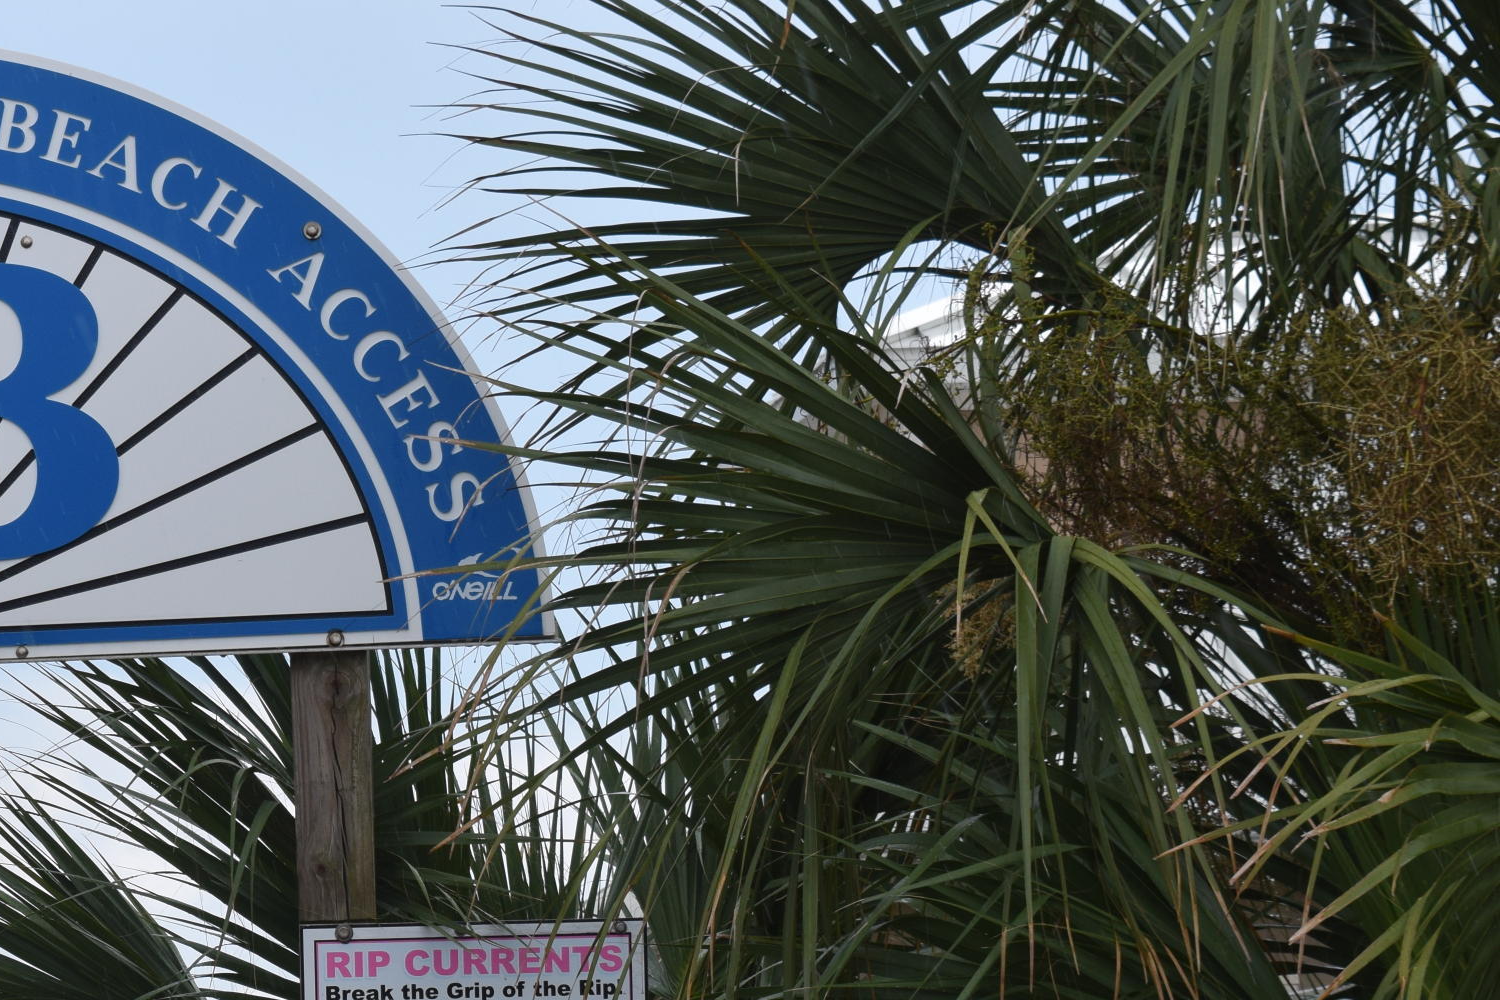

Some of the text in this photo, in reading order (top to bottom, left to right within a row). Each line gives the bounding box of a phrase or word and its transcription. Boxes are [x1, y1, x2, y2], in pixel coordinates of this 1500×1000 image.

[267, 252, 484, 522] ACCESS
[326, 945, 622, 978] RIP CURRENTS
[325, 984, 394, 1000] Break
[401, 983, 438, 1000] the
[503, 981, 525, 997] of
[533, 981, 570, 996] the
